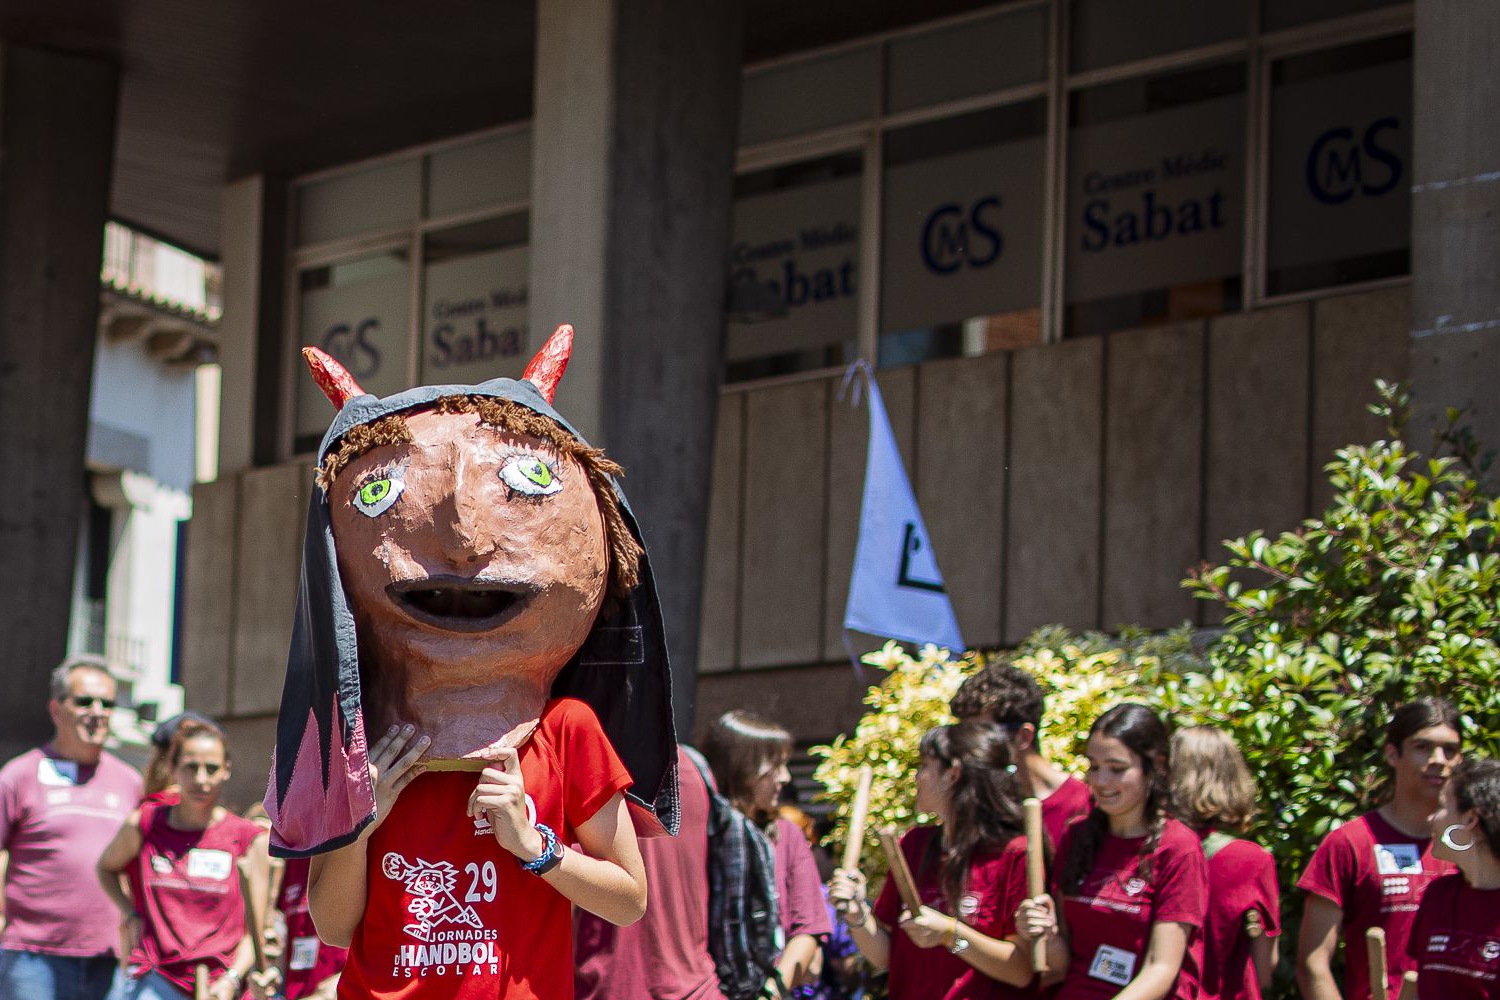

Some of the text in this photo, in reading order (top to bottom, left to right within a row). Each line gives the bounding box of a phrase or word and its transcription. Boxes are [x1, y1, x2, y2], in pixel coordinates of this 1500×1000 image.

[1306, 117, 1403, 205] CMS
[921, 197, 1003, 275] CMS
[1081, 188, 1227, 253] Sabat
[465, 861, 497, 902] 29
[430, 929, 498, 943] JORNADES
[393, 964, 498, 978] ESCOLAR
